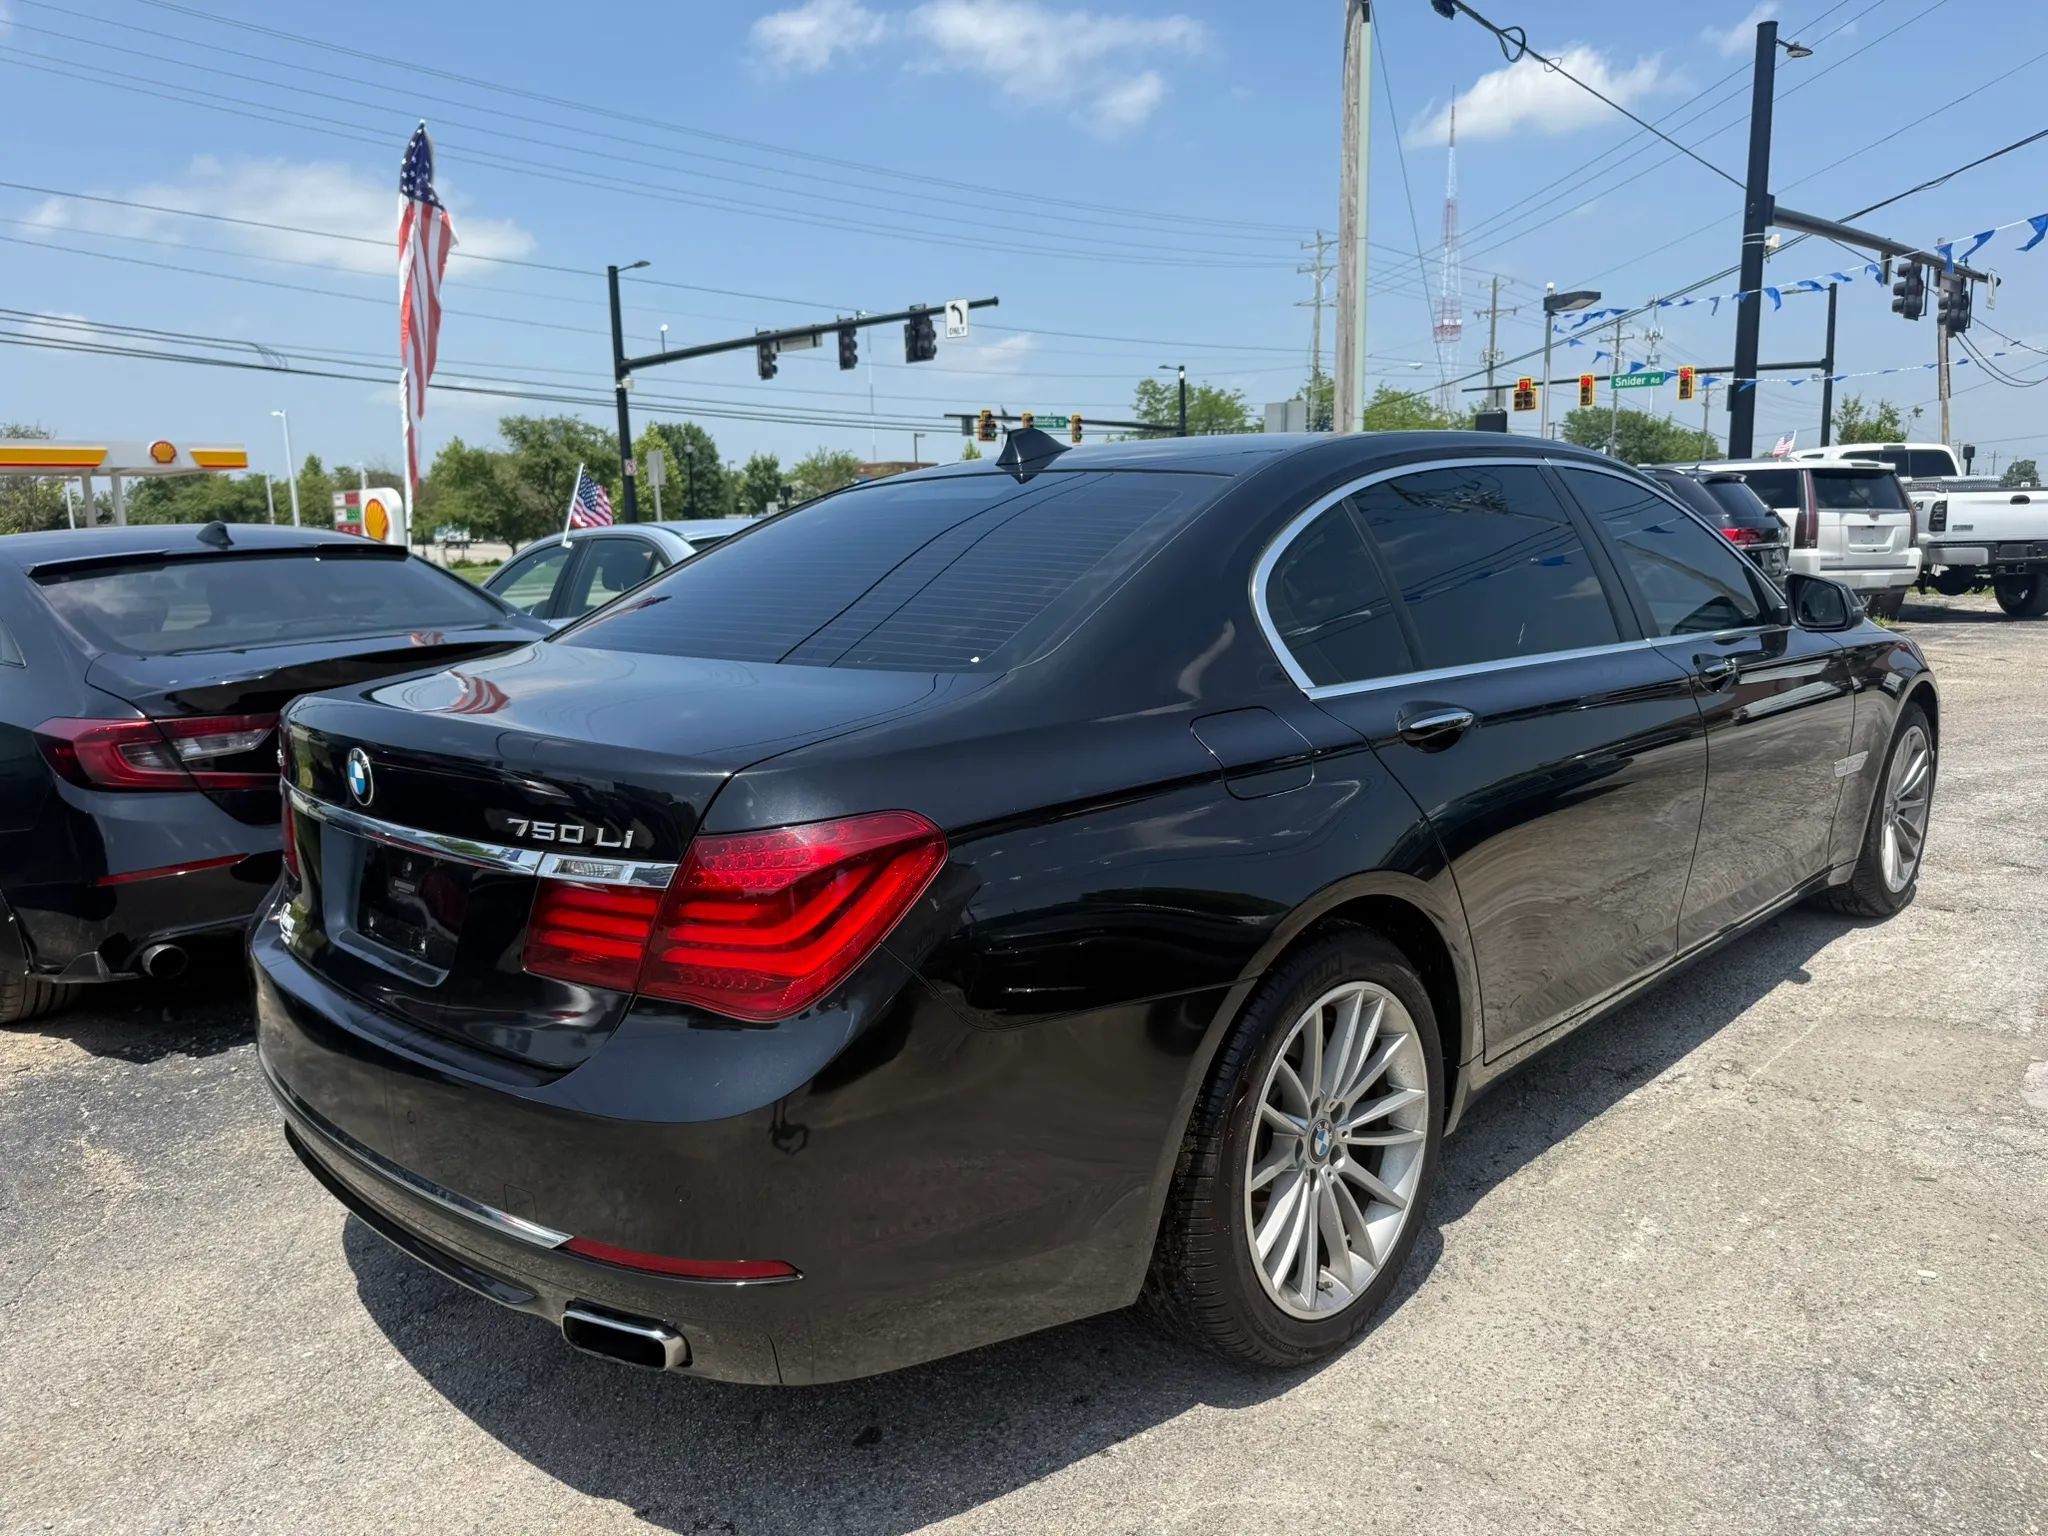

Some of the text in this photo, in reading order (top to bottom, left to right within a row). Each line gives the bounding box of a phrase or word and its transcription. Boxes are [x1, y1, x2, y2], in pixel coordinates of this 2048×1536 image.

[949, 327, 965, 336] ONLY
[1615, 375, 1646, 387] Snider
[507, 818, 634, 849] 750 Li
